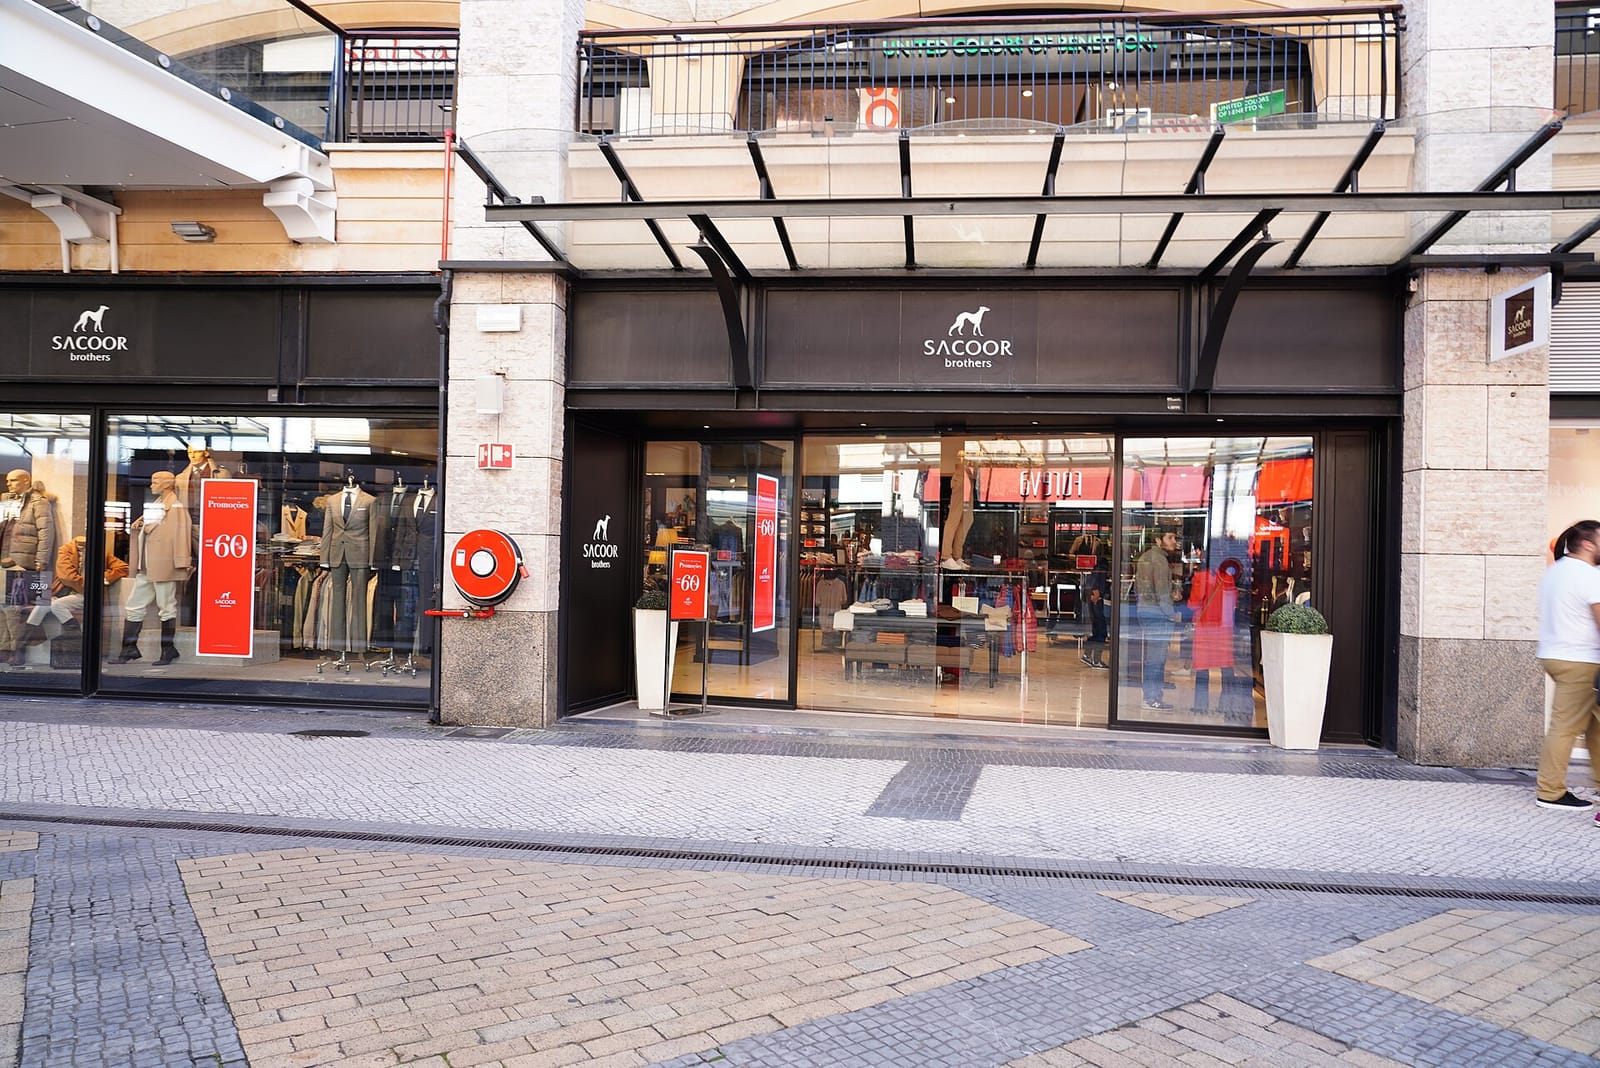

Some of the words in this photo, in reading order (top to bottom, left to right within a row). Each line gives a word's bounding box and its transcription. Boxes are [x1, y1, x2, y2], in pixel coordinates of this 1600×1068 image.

[883, 39, 948, 56] UNITED
[953, 37, 1023, 54] COLORS
[1028, 36, 1052, 52] OF
[1507, 319, 1533, 335] SACOOR
[52, 335, 129, 351] SACOOR
[923, 339, 1013, 356] SACOOR
[70, 352, 111, 362] brothers
[944, 358, 992, 368] brothers
[208, 500, 249, 510] Promoções
[583, 543, 619, 558] SACOOR
